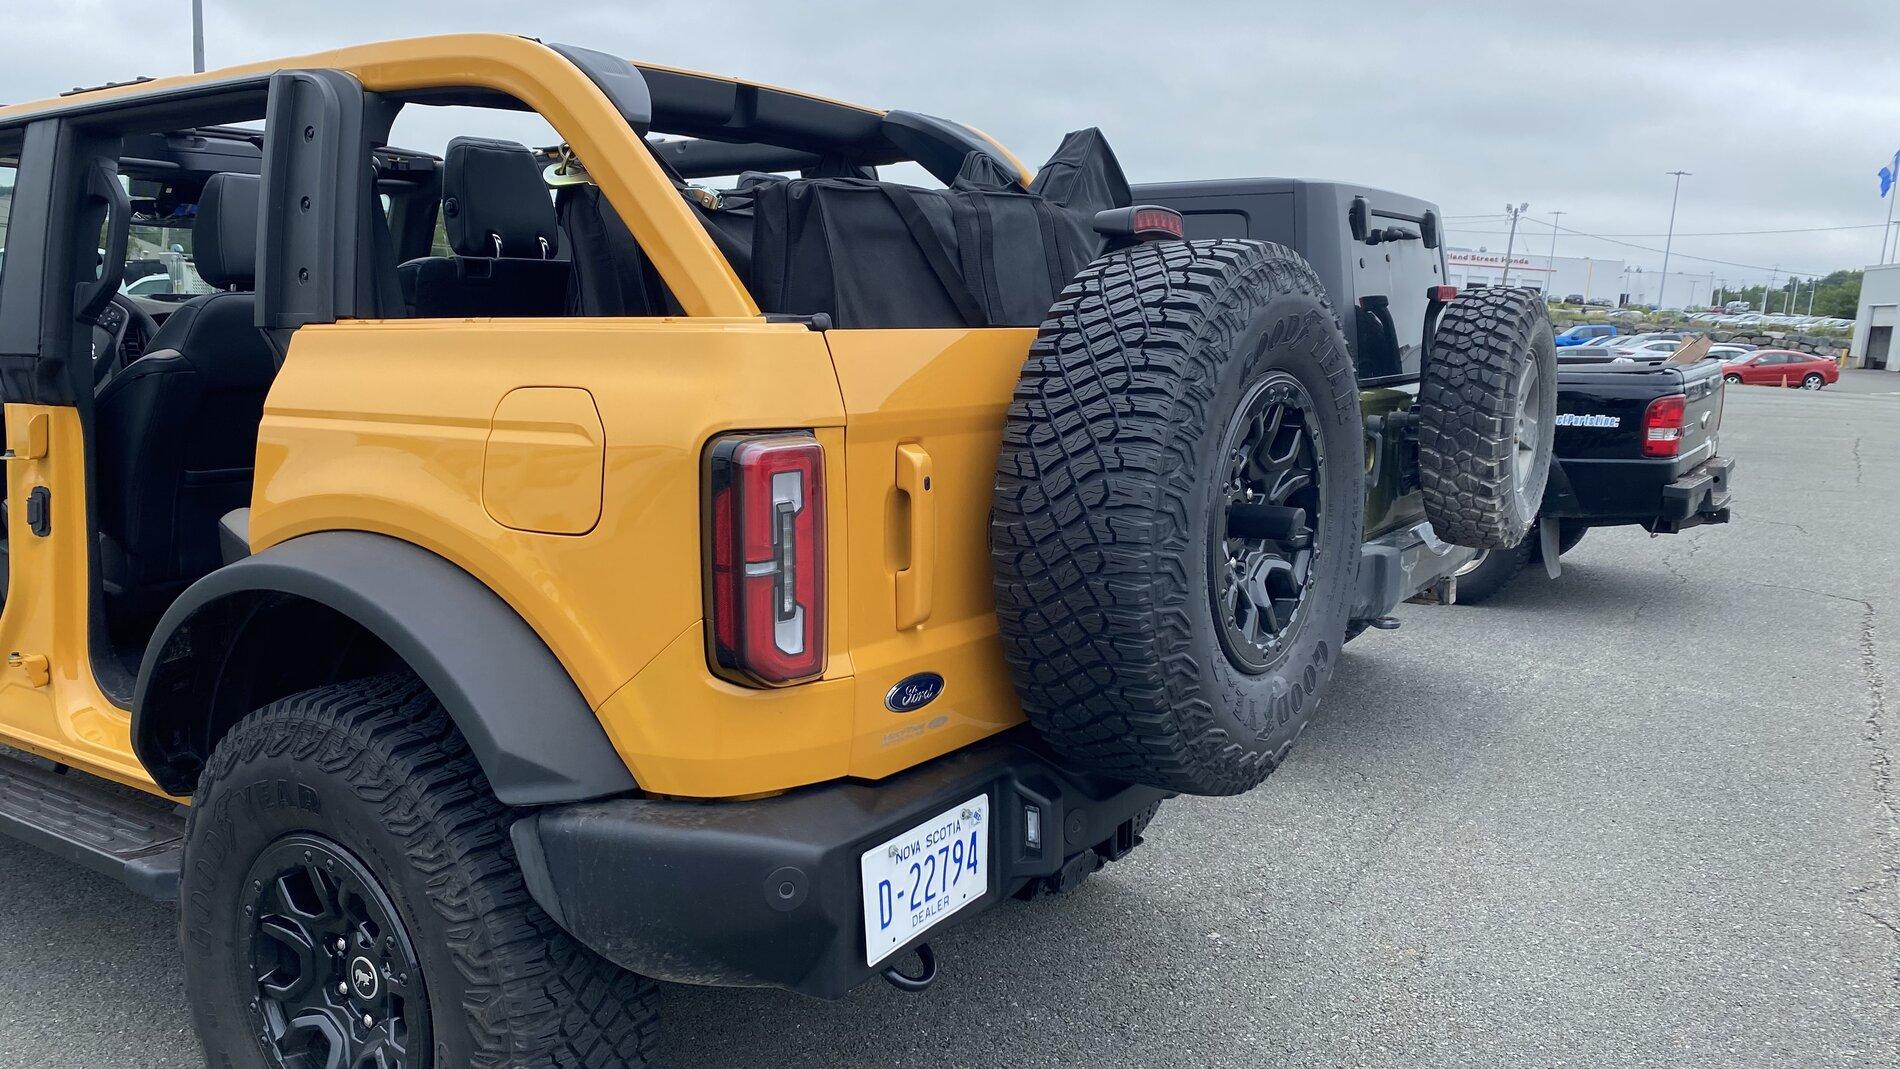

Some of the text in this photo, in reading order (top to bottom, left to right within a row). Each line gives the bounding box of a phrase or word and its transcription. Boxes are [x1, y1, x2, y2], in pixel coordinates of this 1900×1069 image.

[1471, 255, 1499, 263] Street
[1501, 256, 1529, 265] Honda
[1239, 307, 1355, 426] GOODYEAR
[902, 683, 934, 706] Ford
[894, 819, 962, 865] NOVA SCOTIA
[878, 830, 978, 931] D-22794
[912, 895, 950, 928] DEALER
